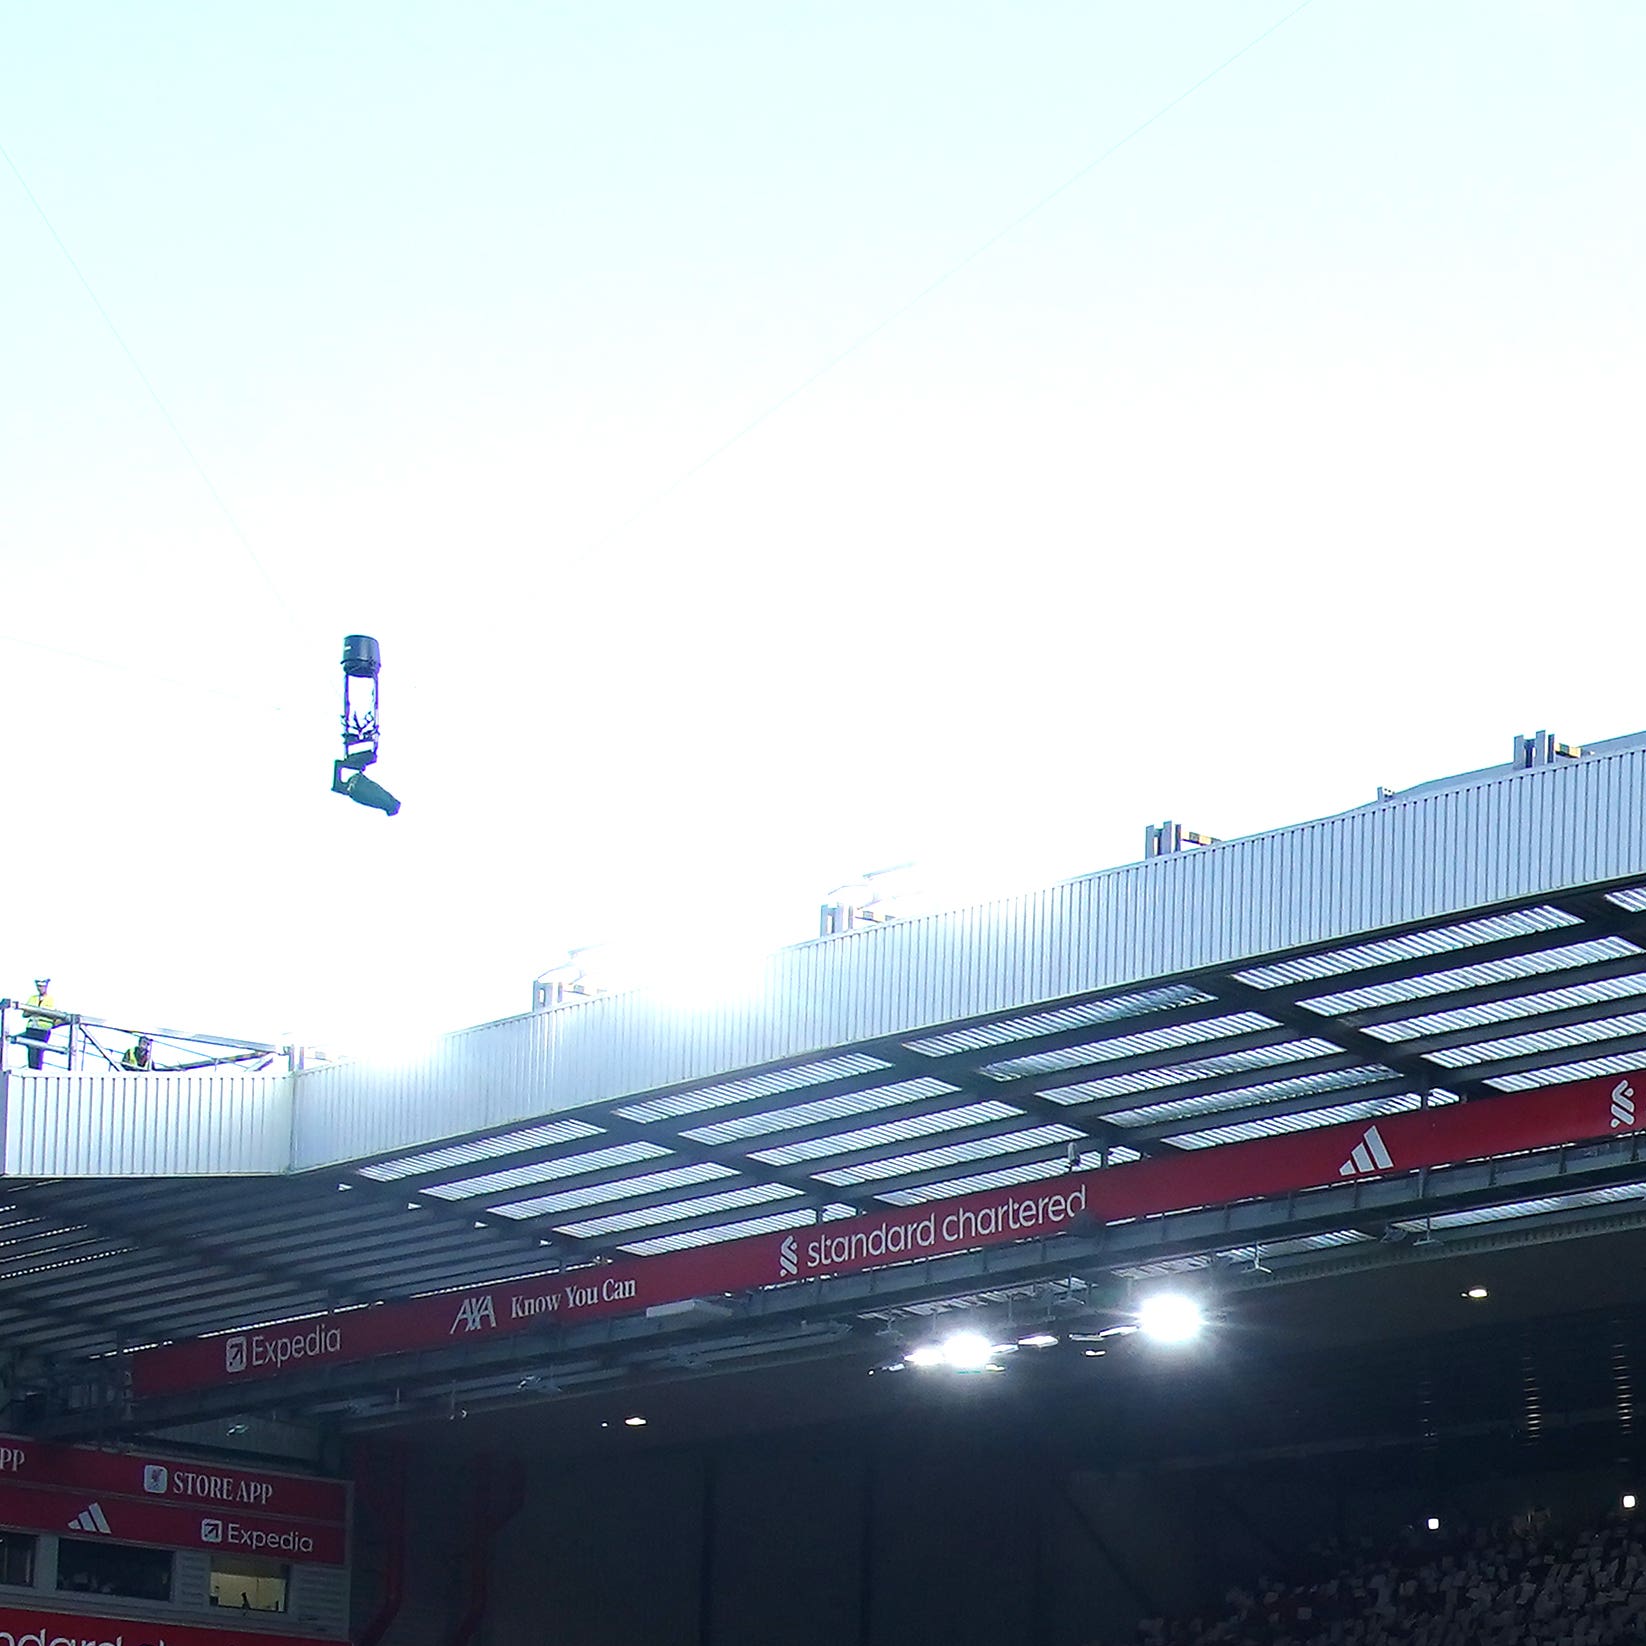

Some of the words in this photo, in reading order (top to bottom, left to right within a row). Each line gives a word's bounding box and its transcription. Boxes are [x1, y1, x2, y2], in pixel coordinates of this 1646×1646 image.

[807, 1212, 936, 1268] standard
[942, 1184, 1087, 1242] chartered
[450, 1295, 497, 1335] AXA
[511, 1290, 562, 1319] Know
[565, 1284, 600, 1308] You
[602, 1276, 636, 1301] Can
[251, 1324, 342, 1368] Expedia
[173, 1471, 233, 1501] STORE
[236, 1479, 273, 1504] APP
[228, 1523, 313, 1553] Expedia
